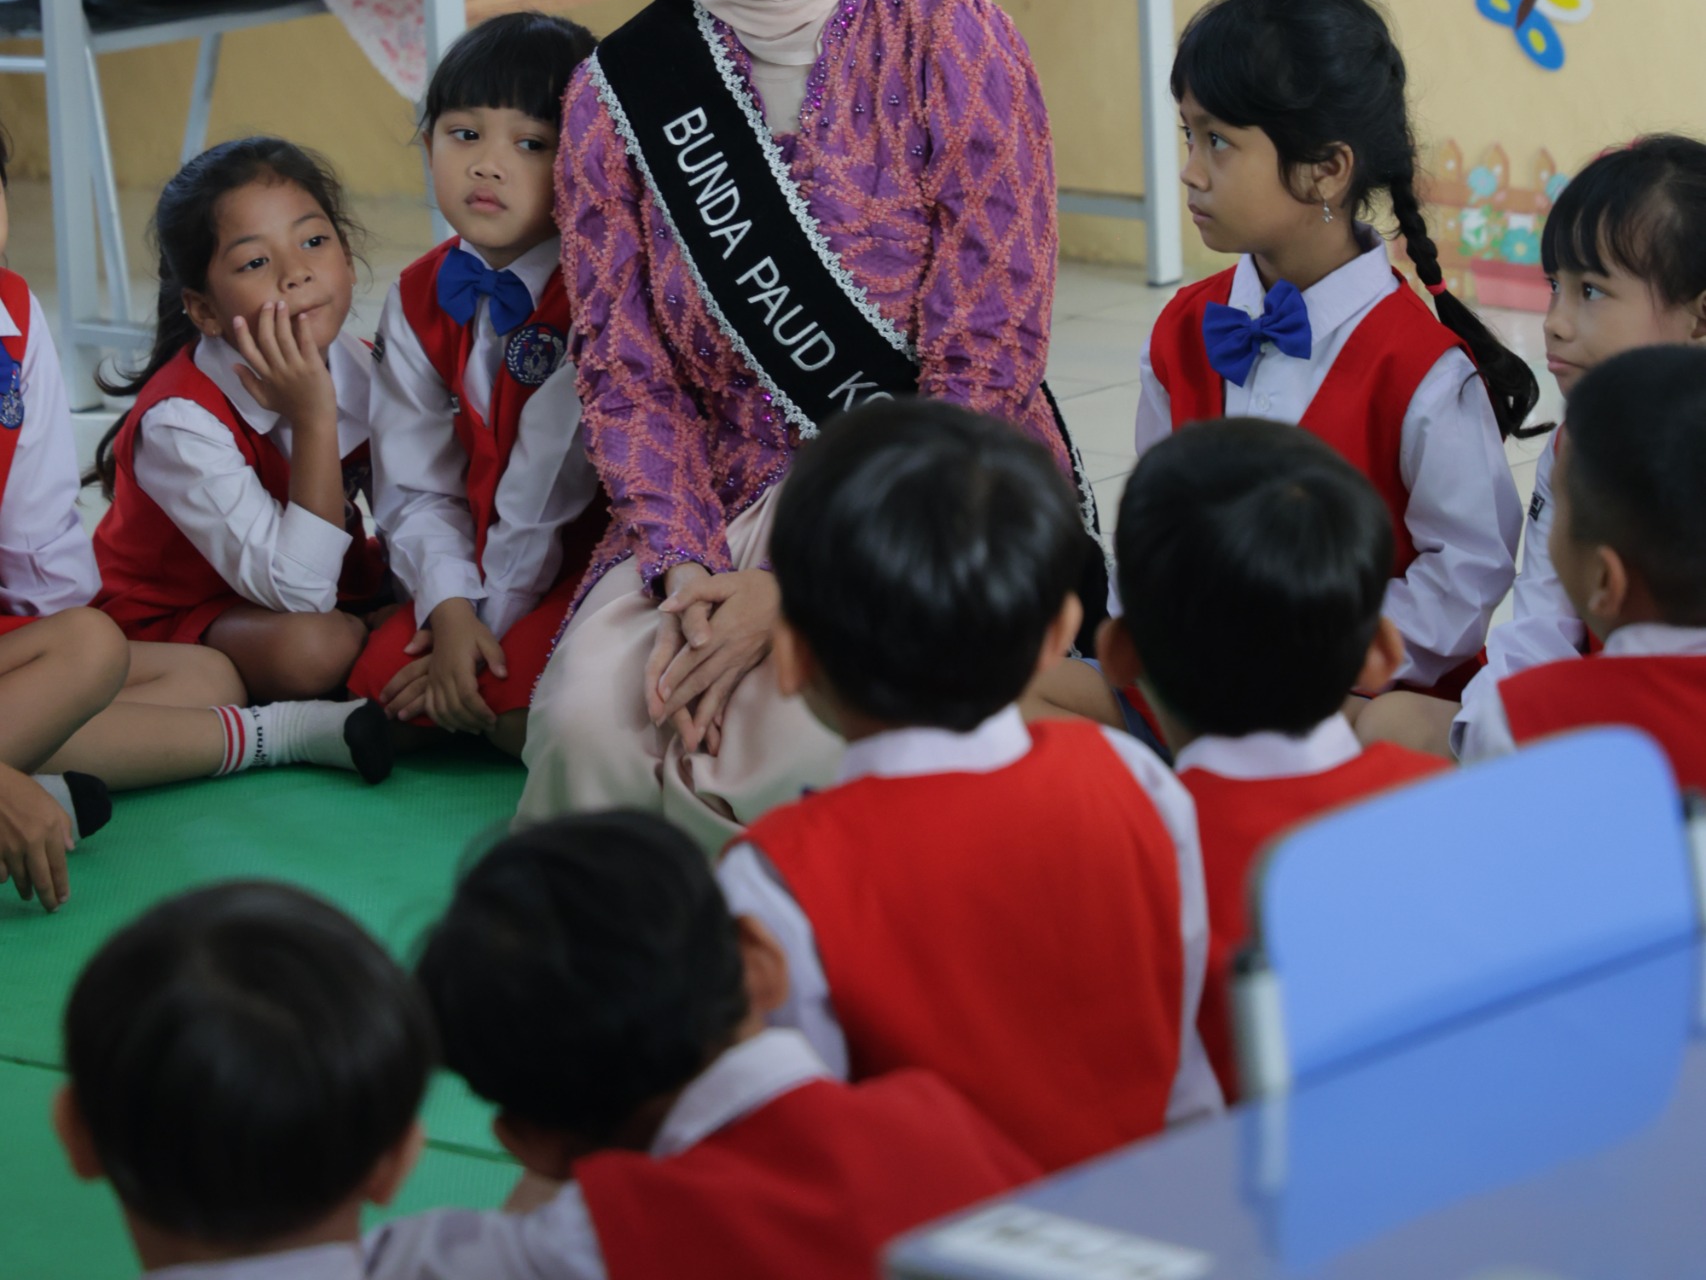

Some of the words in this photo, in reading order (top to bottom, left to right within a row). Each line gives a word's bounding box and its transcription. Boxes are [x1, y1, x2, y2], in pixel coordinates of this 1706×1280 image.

[662, 106, 753, 261] BUNDA
[735, 255, 837, 372] PAUD
[827, 370, 896, 413] K
